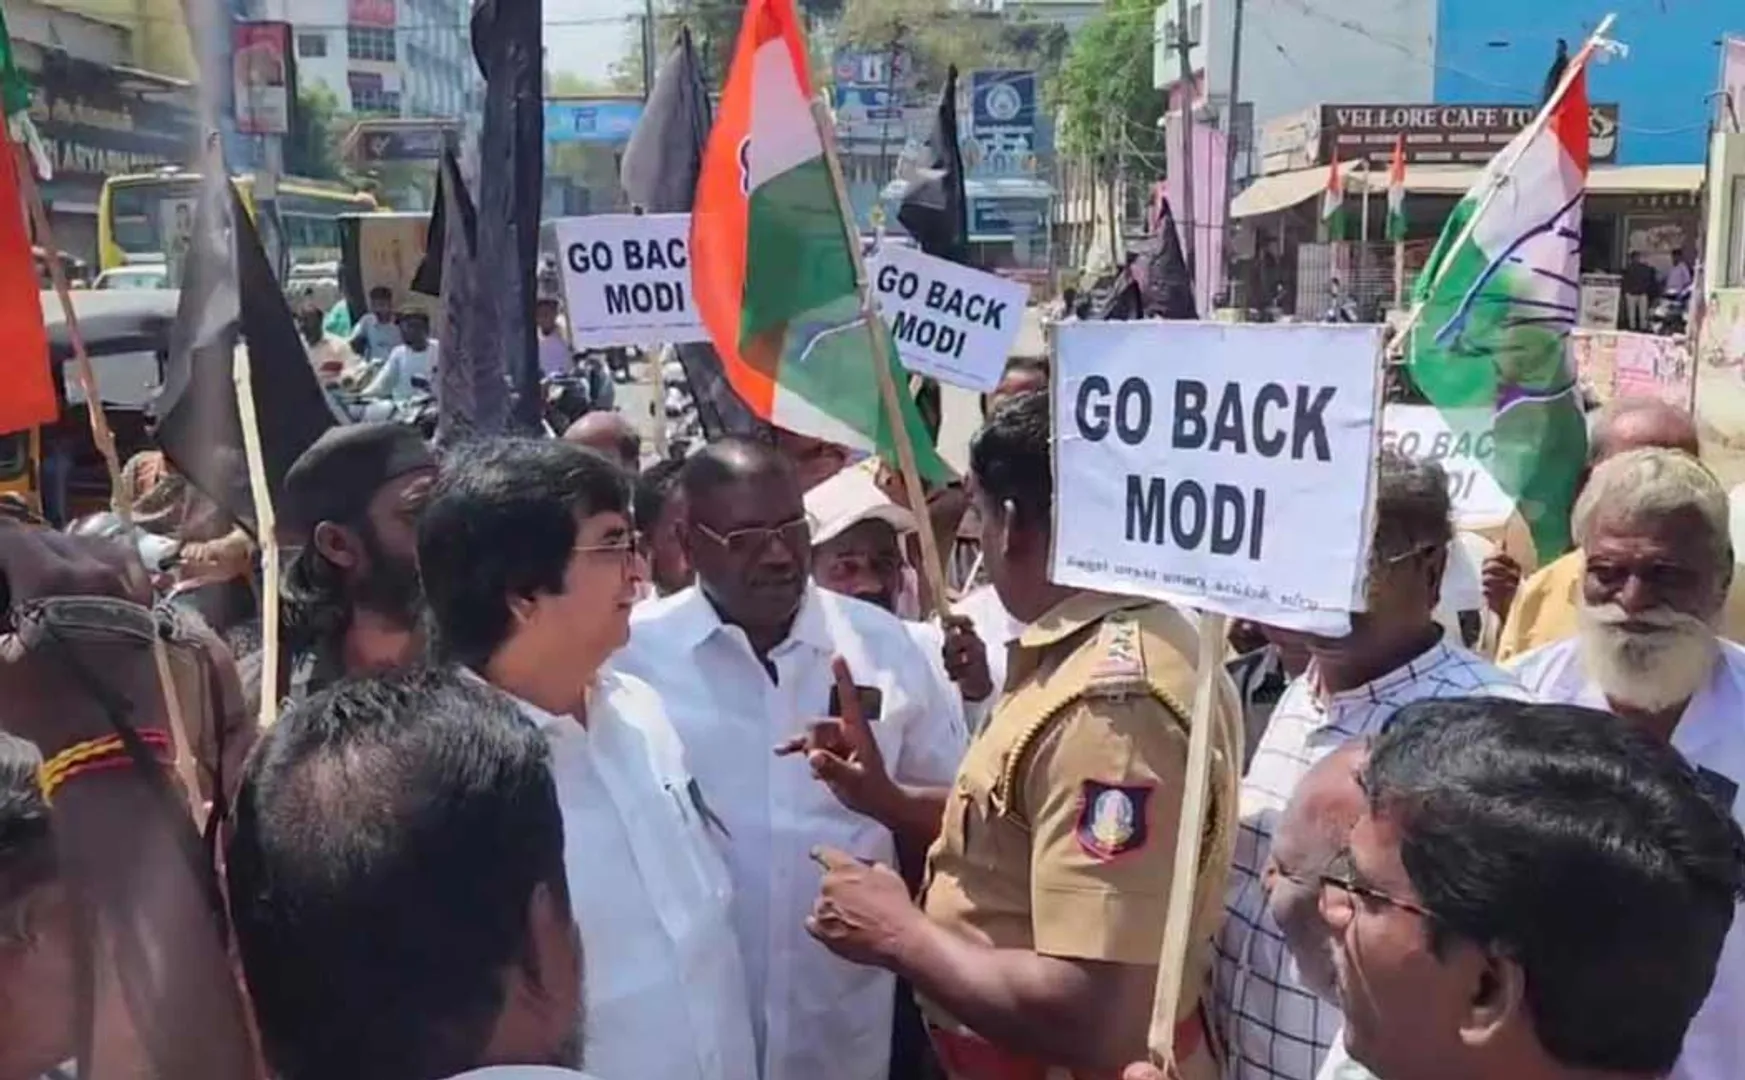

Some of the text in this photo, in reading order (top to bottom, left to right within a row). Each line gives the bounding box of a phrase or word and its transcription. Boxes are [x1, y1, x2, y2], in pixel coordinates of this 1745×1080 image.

[1336, 107, 1438, 128] VELLORE
[1441, 108, 1499, 128] CAFE
[568, 238, 687, 273] GO BAC
[604, 281, 685, 315] MODI
[877, 264, 1007, 330] GO BACK
[891, 311, 967, 359] MODI
[1075, 374, 1337, 462] GO BACK
[1424, 429, 1496, 461] BAC
[1125, 474, 1266, 560] MODI
